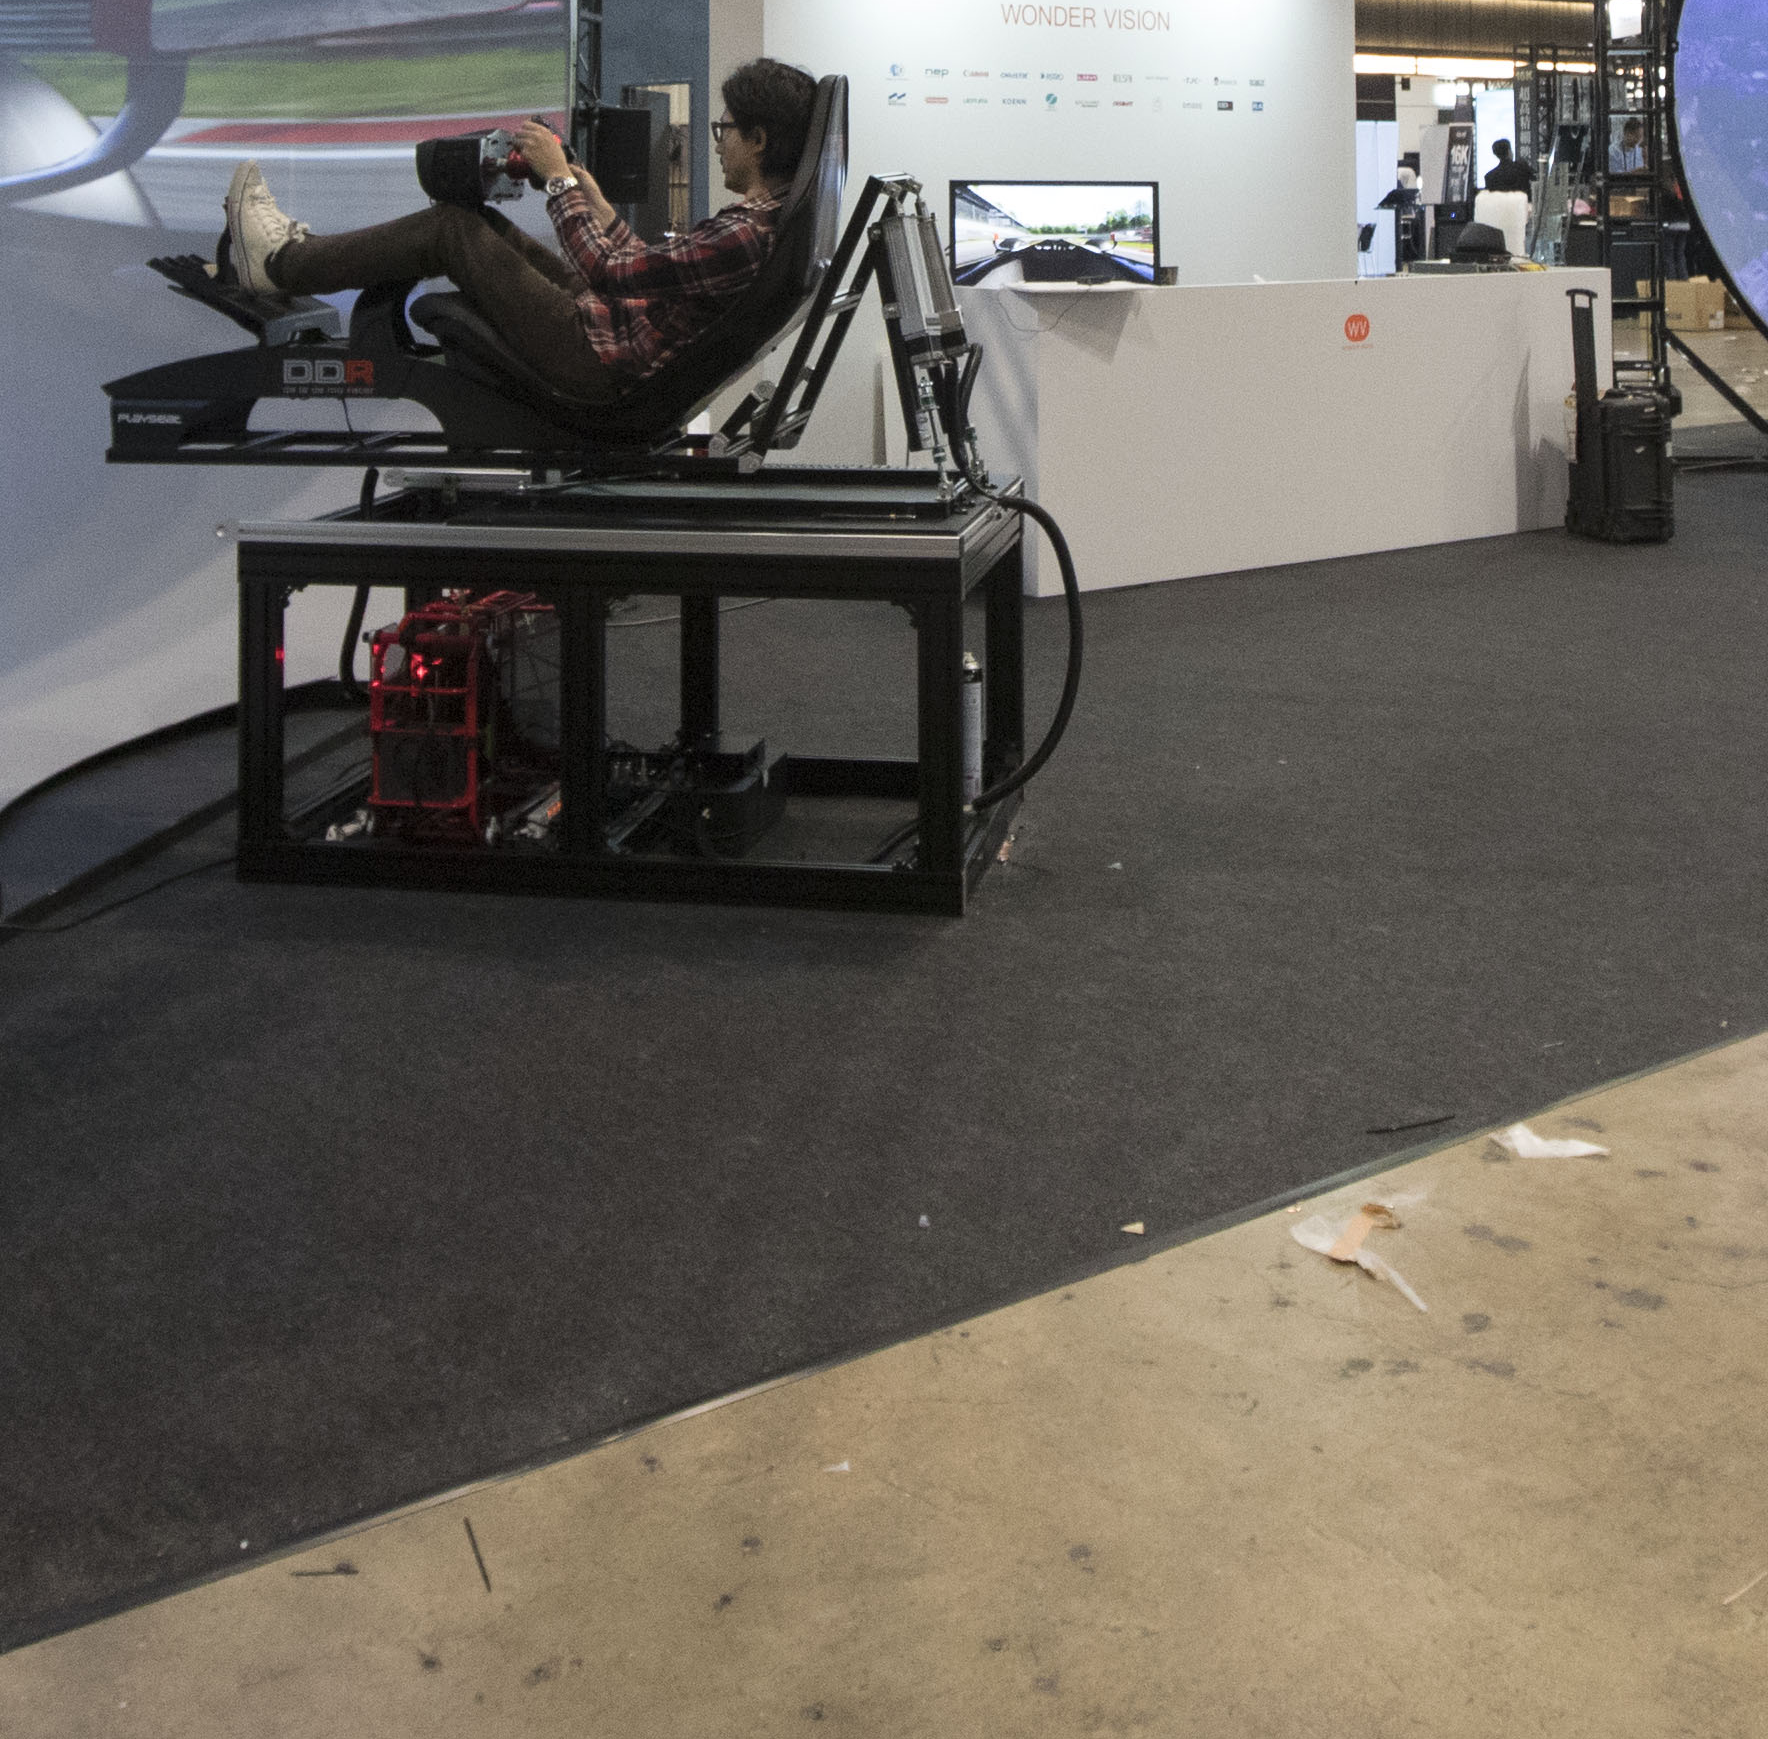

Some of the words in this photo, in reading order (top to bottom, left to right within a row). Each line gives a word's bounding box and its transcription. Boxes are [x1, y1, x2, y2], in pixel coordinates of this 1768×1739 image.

[1000, 3, 1096, 29] WONDER
[1103, 8, 1171, 32] VISION
[924, 67, 950, 81] nep
[1451, 144, 1469, 165] 16K
[1346, 320, 1368, 337] WV
[283, 359, 375, 385] DDR
